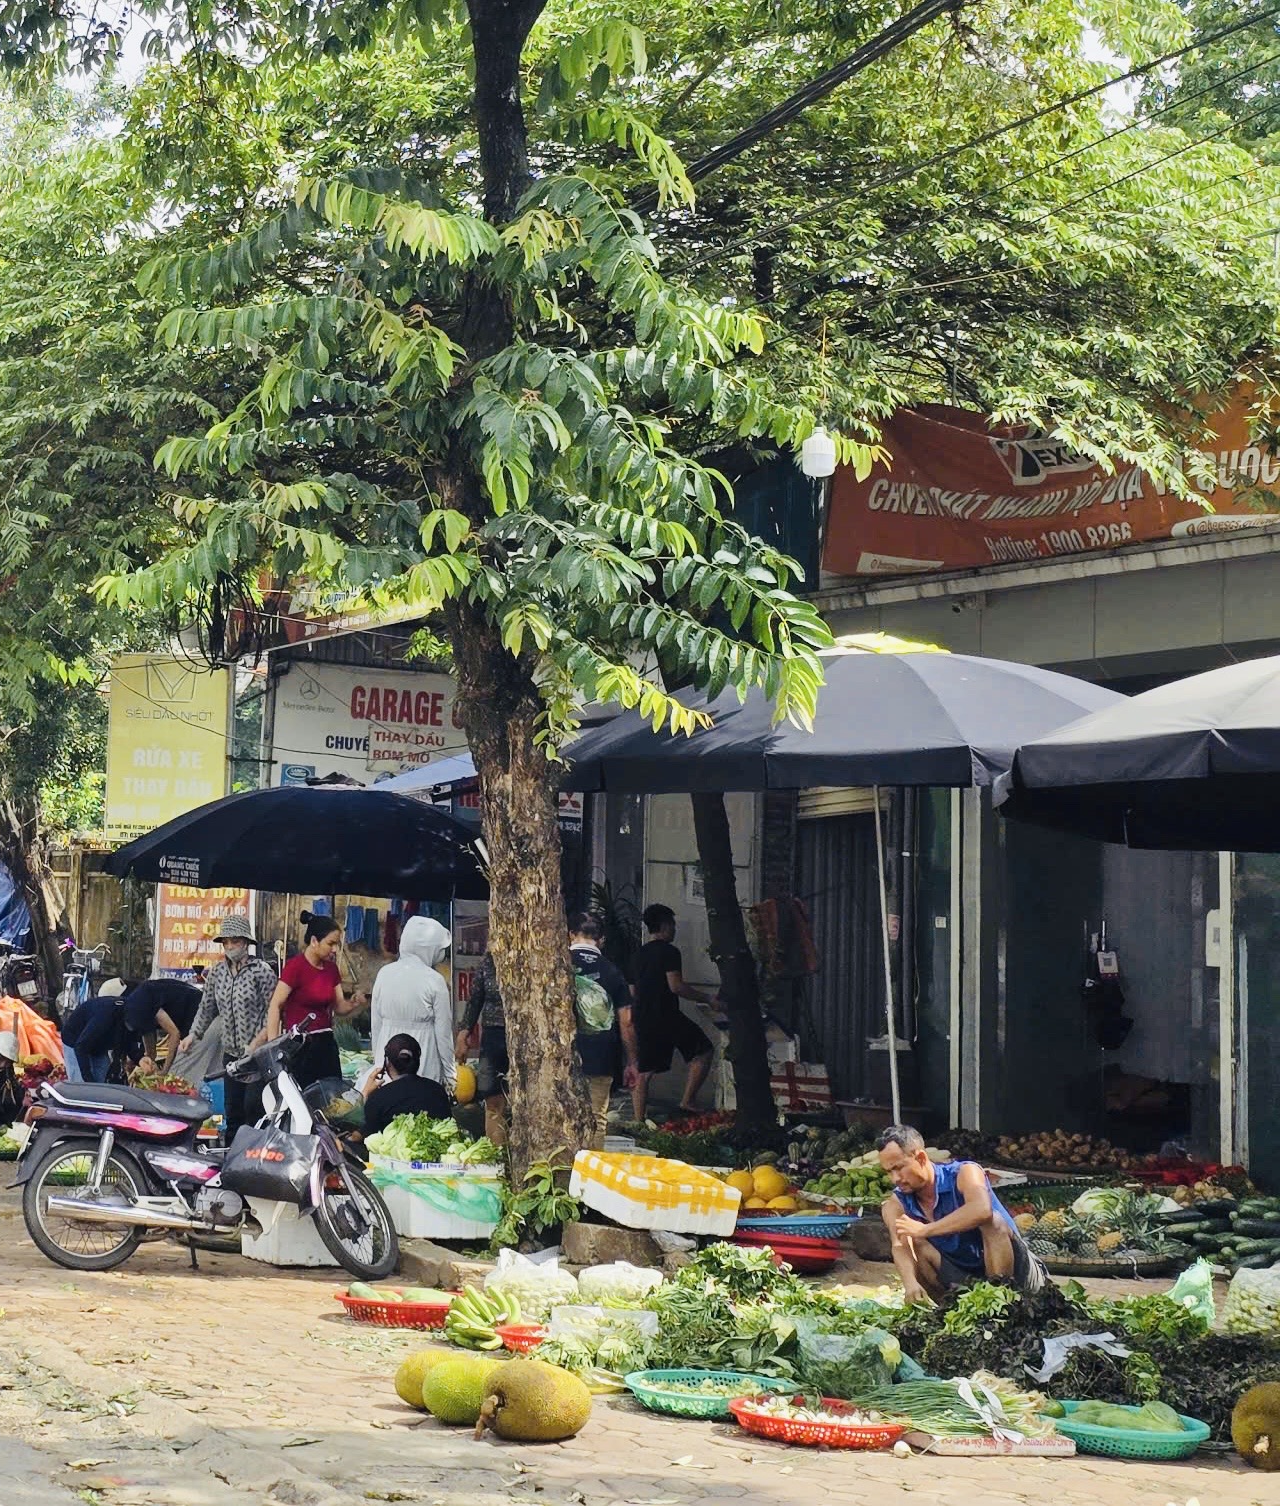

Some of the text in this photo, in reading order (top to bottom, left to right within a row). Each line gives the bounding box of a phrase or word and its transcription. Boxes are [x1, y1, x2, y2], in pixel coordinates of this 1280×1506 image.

[1040, 528, 1086, 555] 1900
[351, 685, 445, 727] GARAGE
[374, 730, 412, 745] THAY
